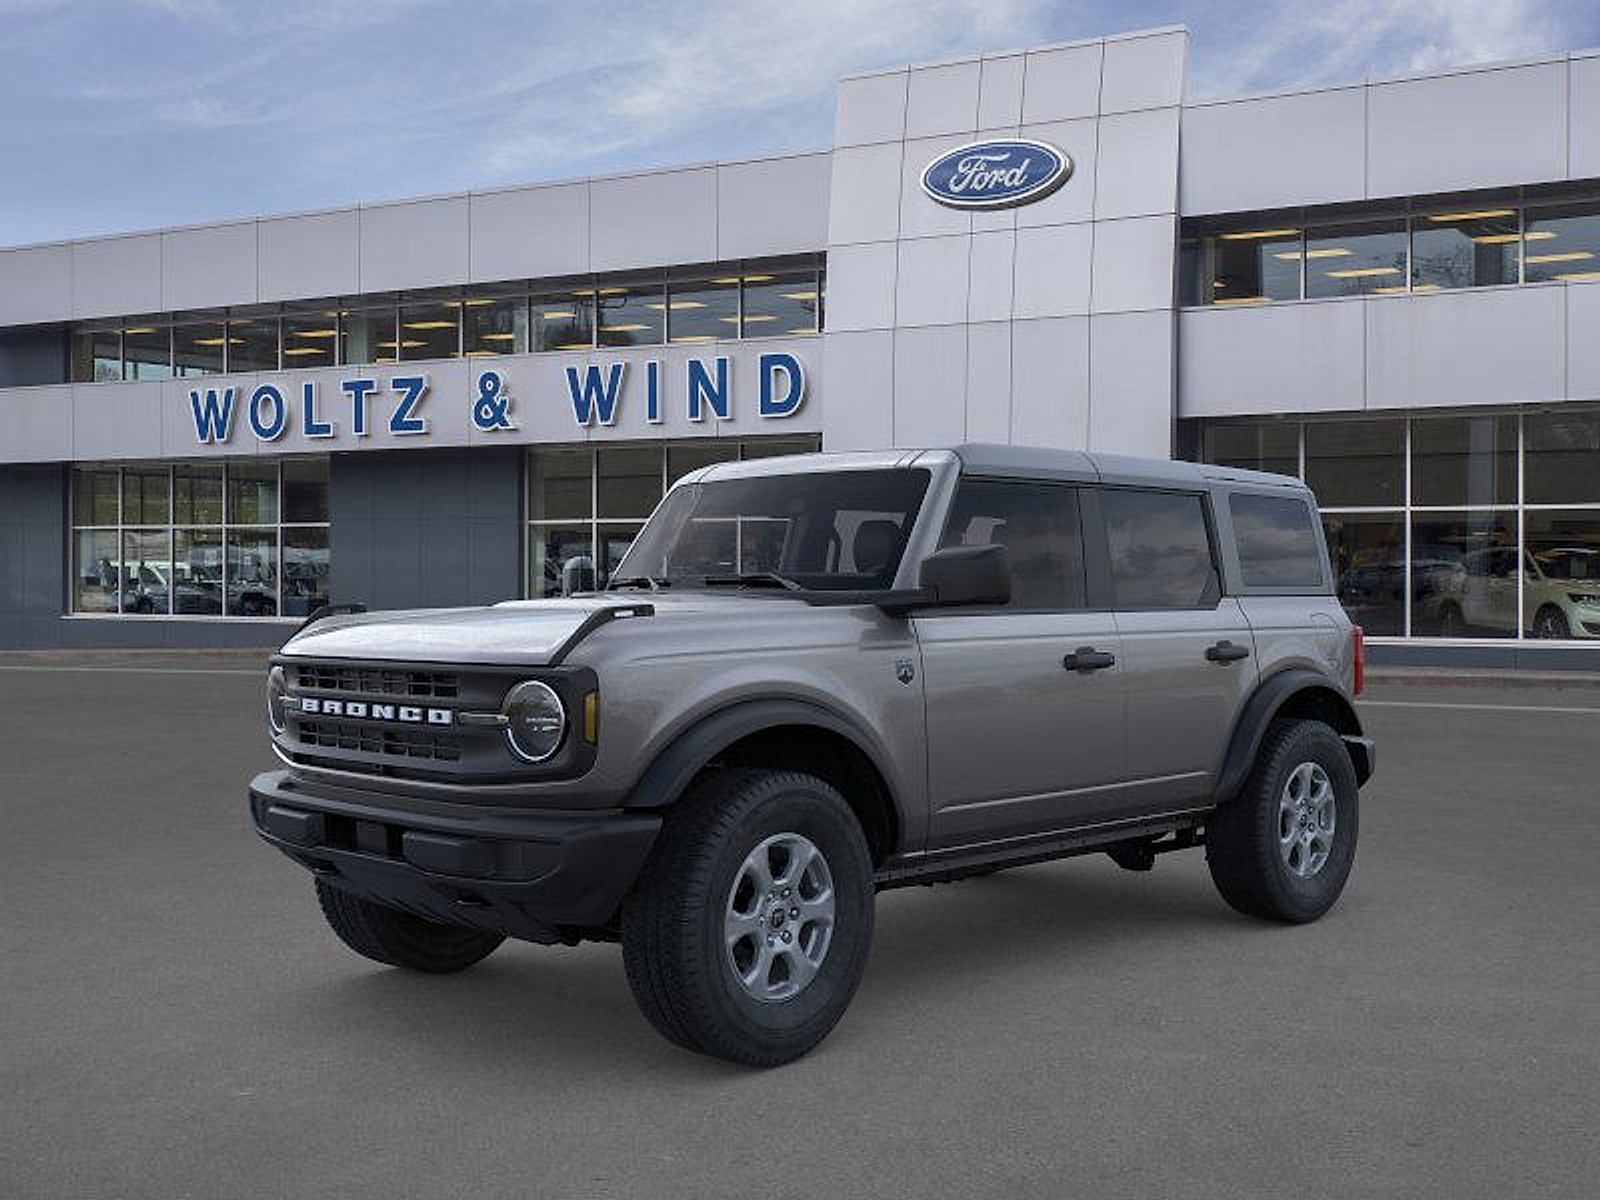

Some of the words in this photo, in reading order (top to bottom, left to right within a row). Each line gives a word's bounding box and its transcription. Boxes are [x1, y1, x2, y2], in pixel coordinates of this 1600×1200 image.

[950, 153, 1031, 193] Ford
[189, 377, 429, 443] WOLTZ
[472, 371, 514, 431] &
[566, 352, 807, 426] WIND
[301, 698, 452, 724] BRONCO
